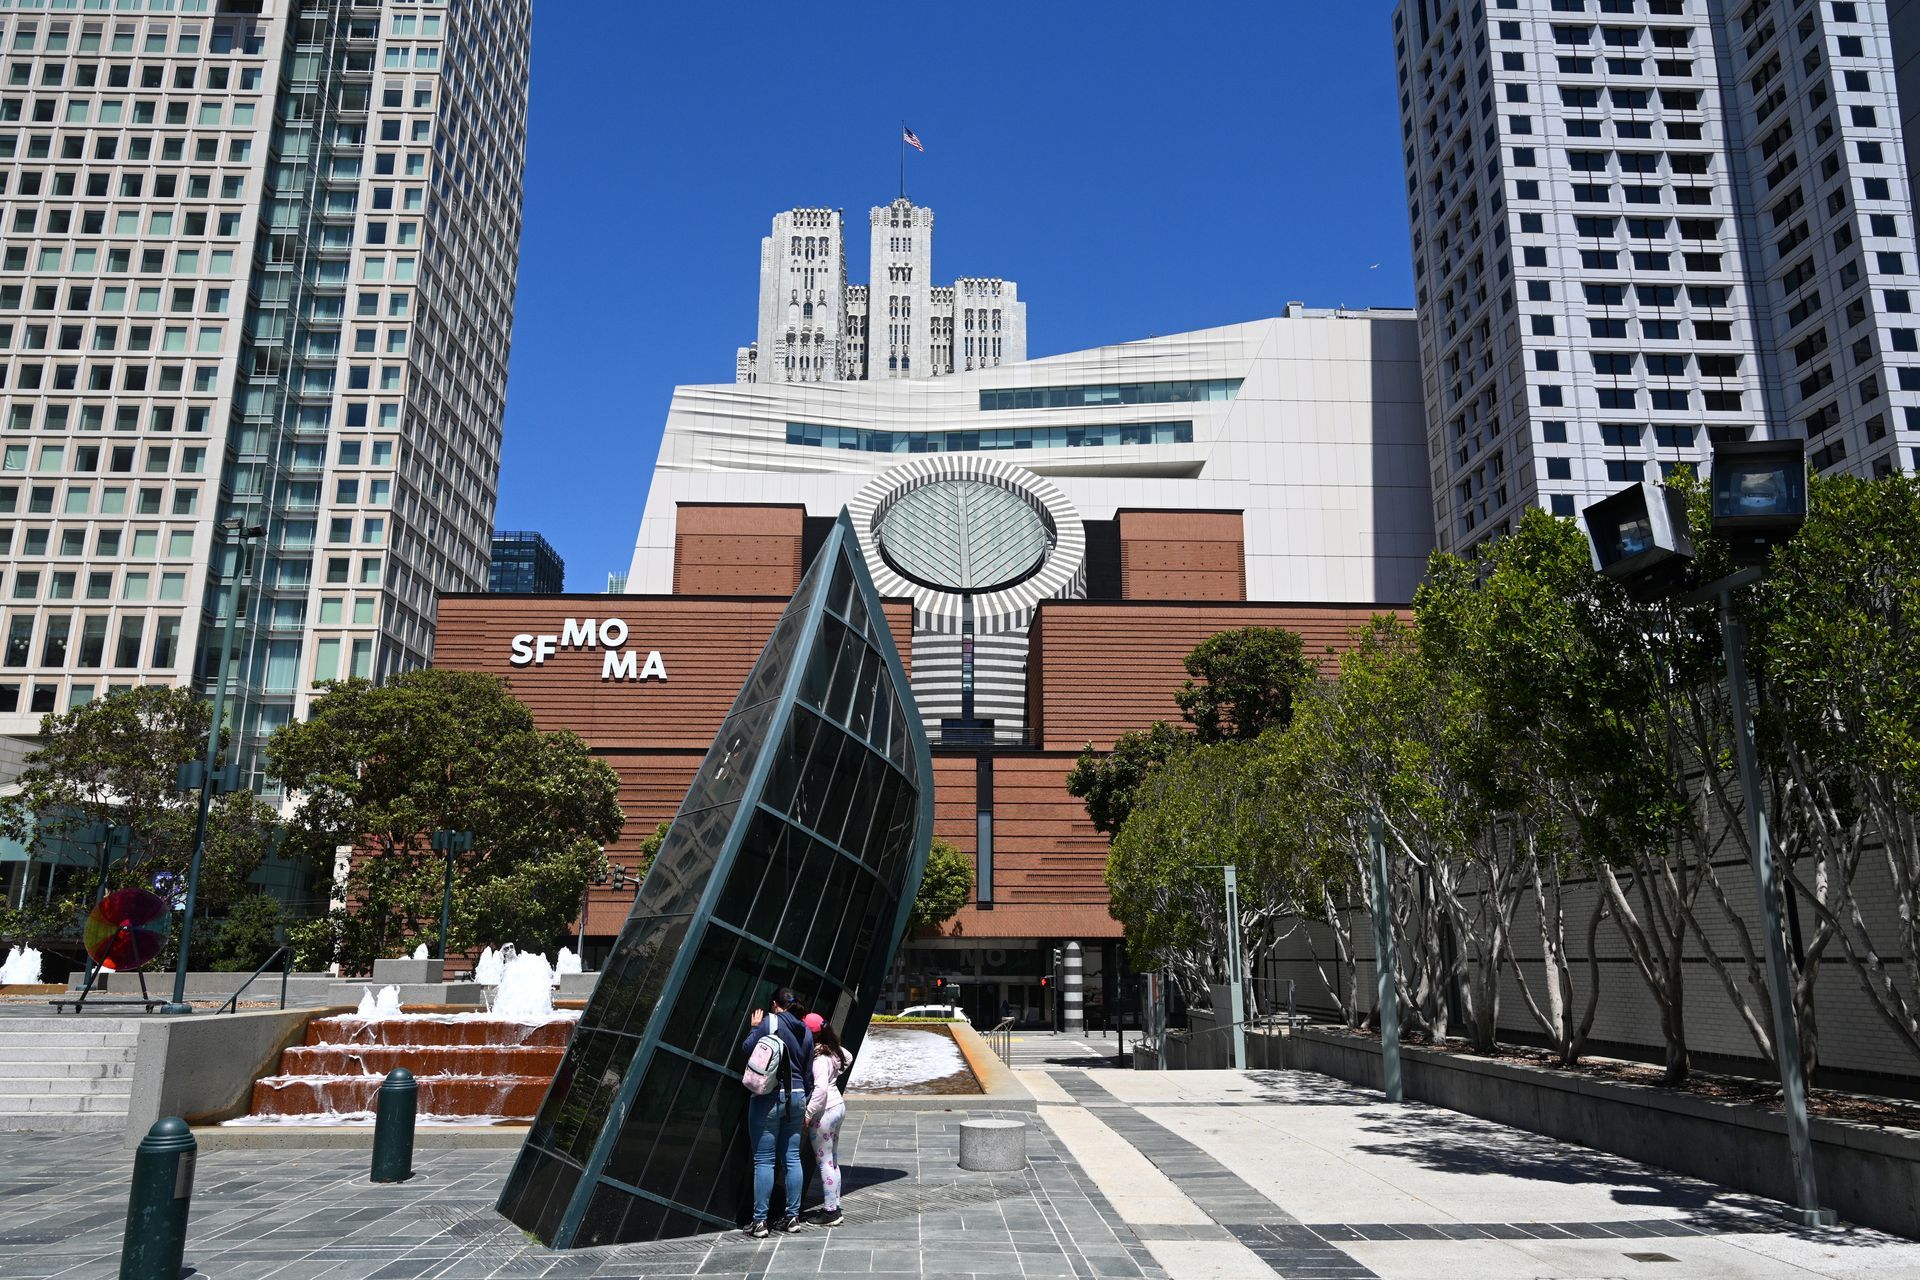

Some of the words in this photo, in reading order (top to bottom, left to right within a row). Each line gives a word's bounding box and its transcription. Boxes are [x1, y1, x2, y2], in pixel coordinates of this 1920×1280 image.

[560, 618, 629, 647] MO
[510, 634, 558, 664] SF
[601, 650, 668, 679] MA
